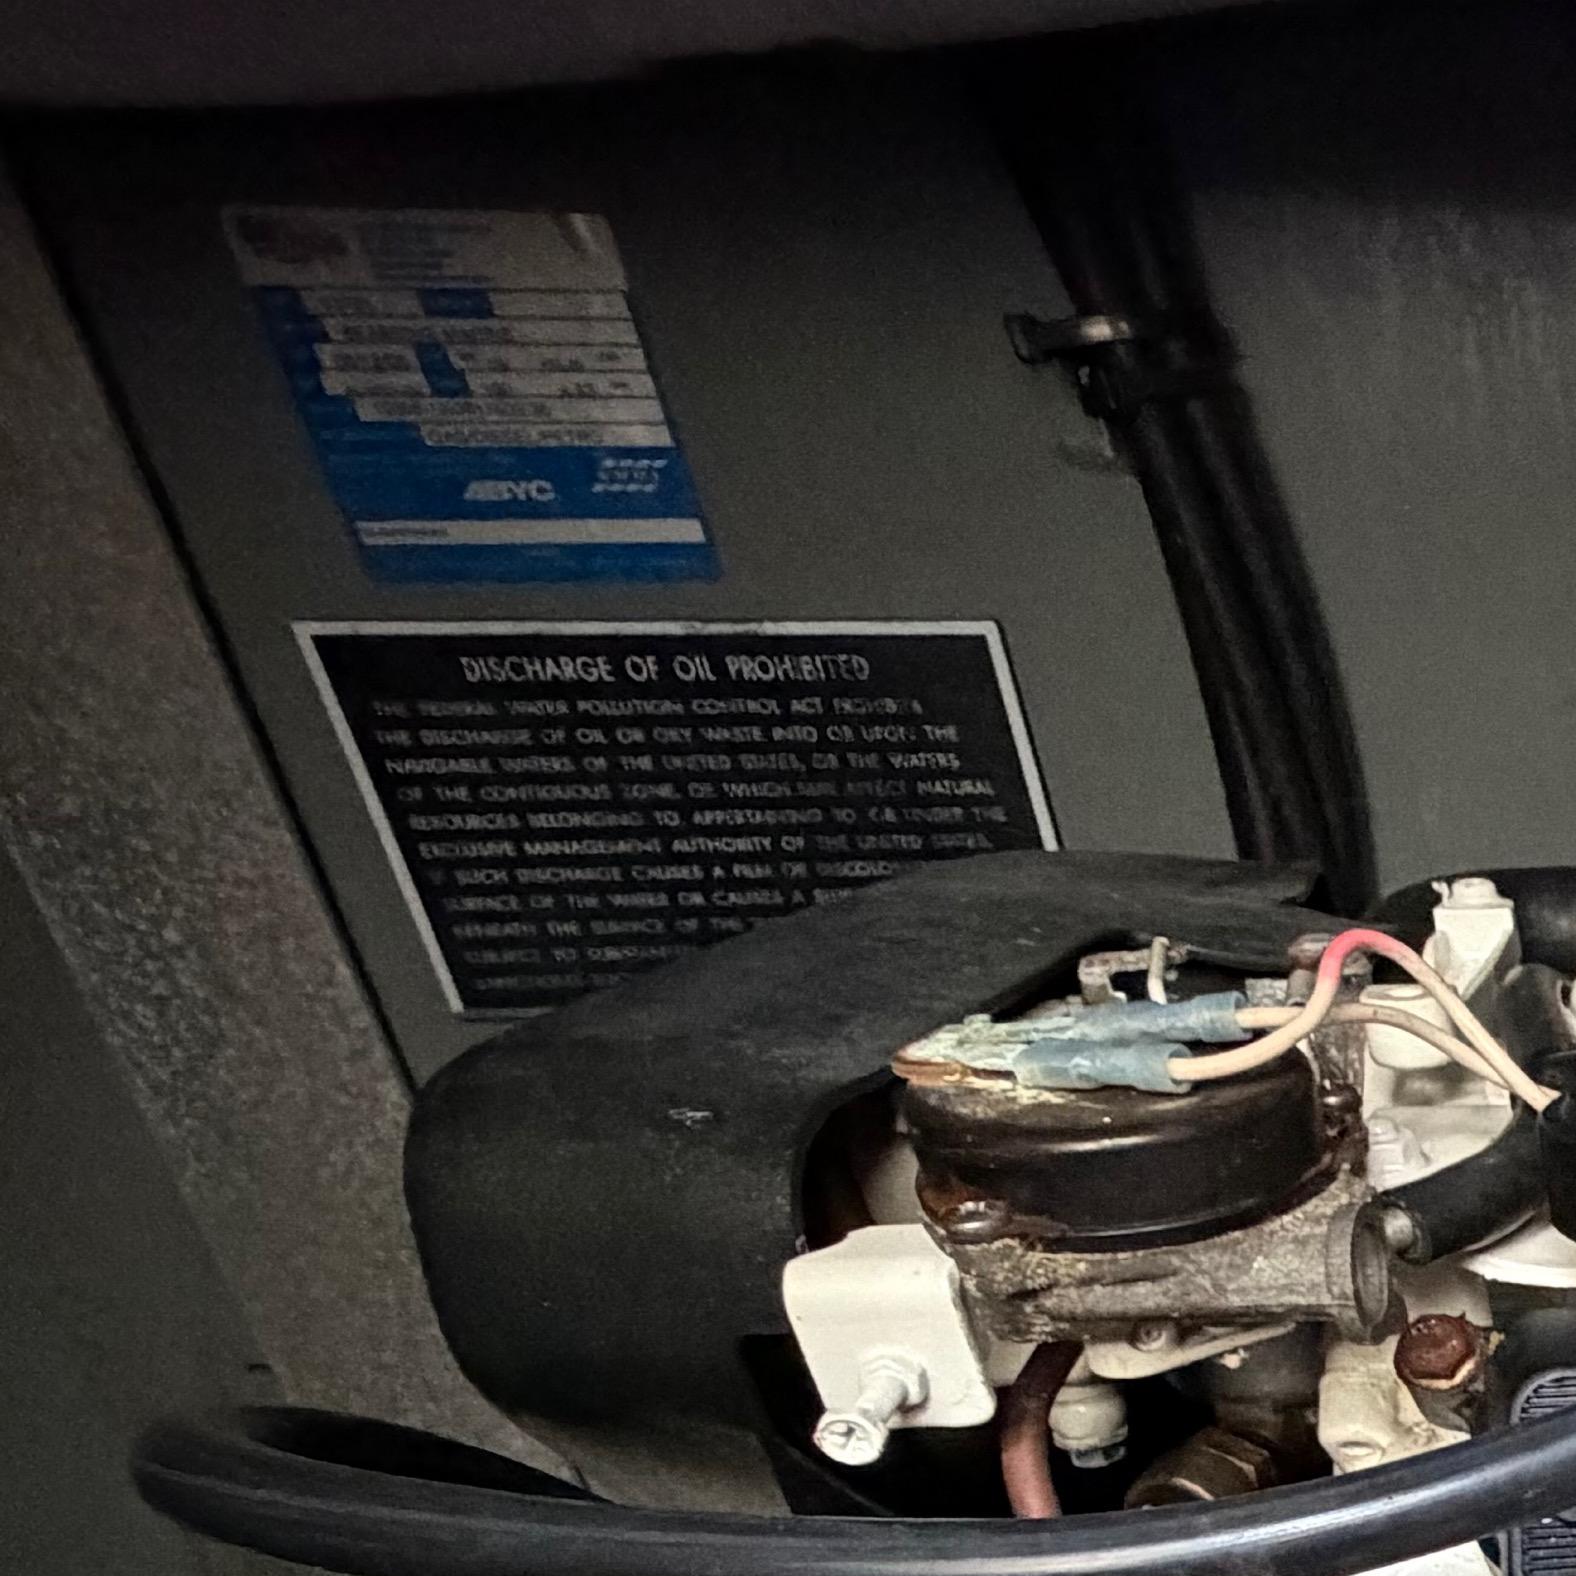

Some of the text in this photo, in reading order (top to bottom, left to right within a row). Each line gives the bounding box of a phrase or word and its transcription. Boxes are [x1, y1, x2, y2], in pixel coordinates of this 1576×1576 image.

[459, 654, 870, 683] DISCHARGE OF OIL PROHIBITED
